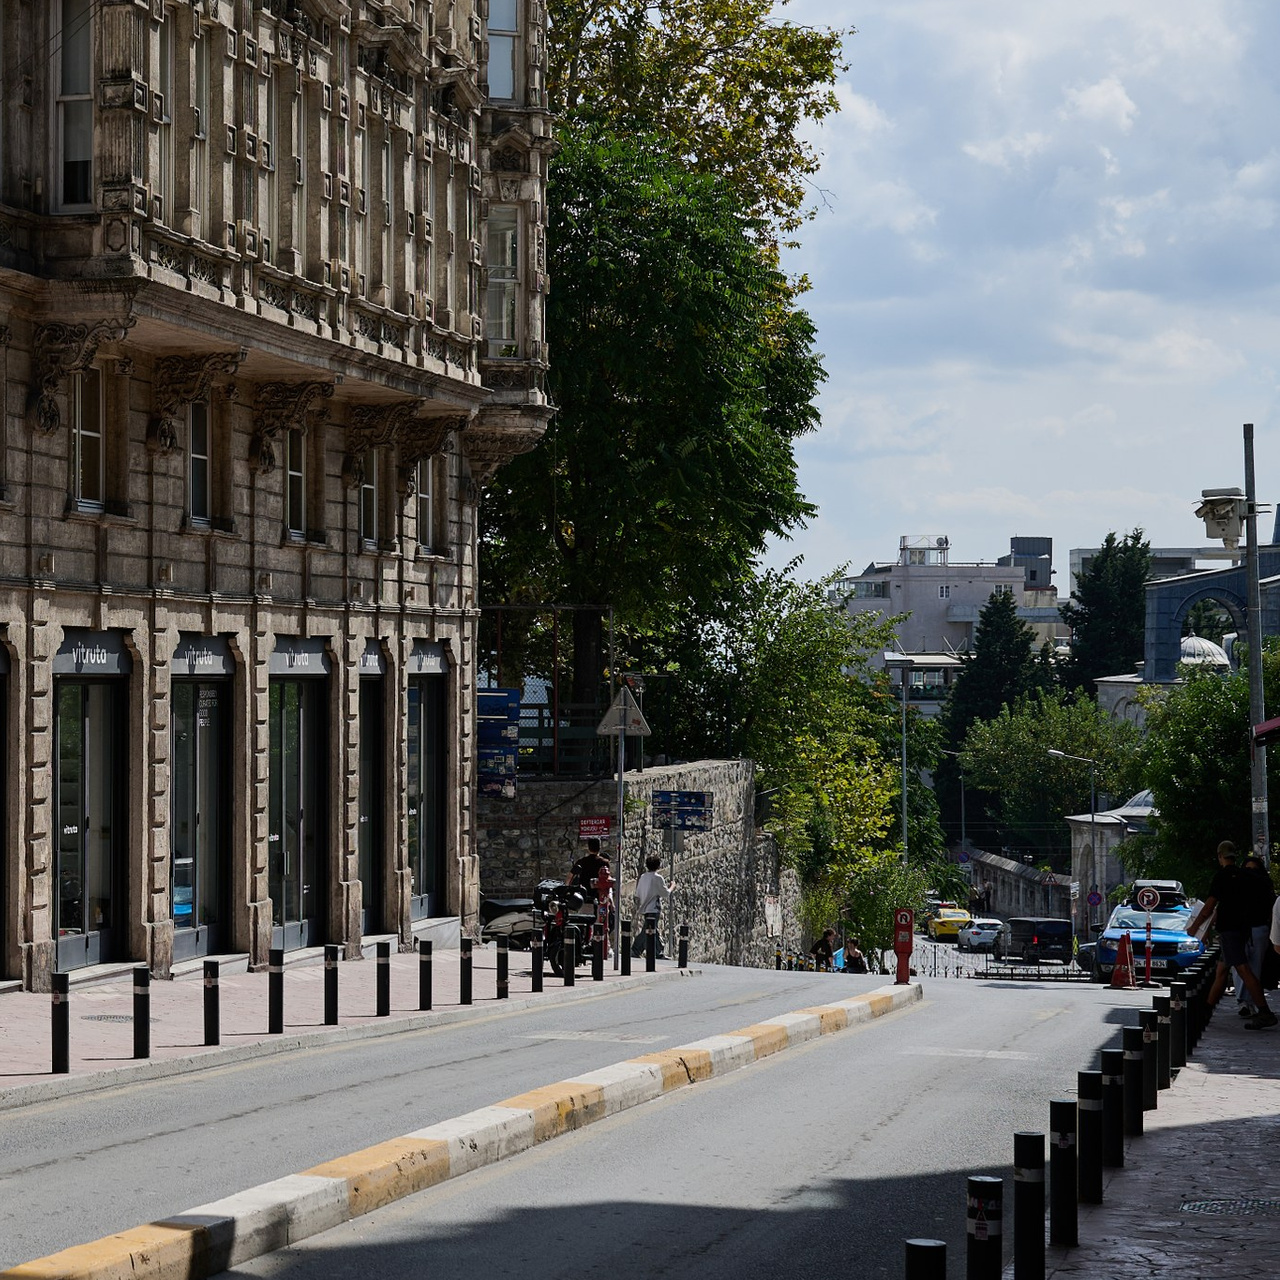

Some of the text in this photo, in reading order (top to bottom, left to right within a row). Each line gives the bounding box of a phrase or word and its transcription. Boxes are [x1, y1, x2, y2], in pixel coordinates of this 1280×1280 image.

[72, 641, 107, 664] vitruta
[185, 644, 213, 665] vitruta
[284, 647, 309, 666] vitruta
